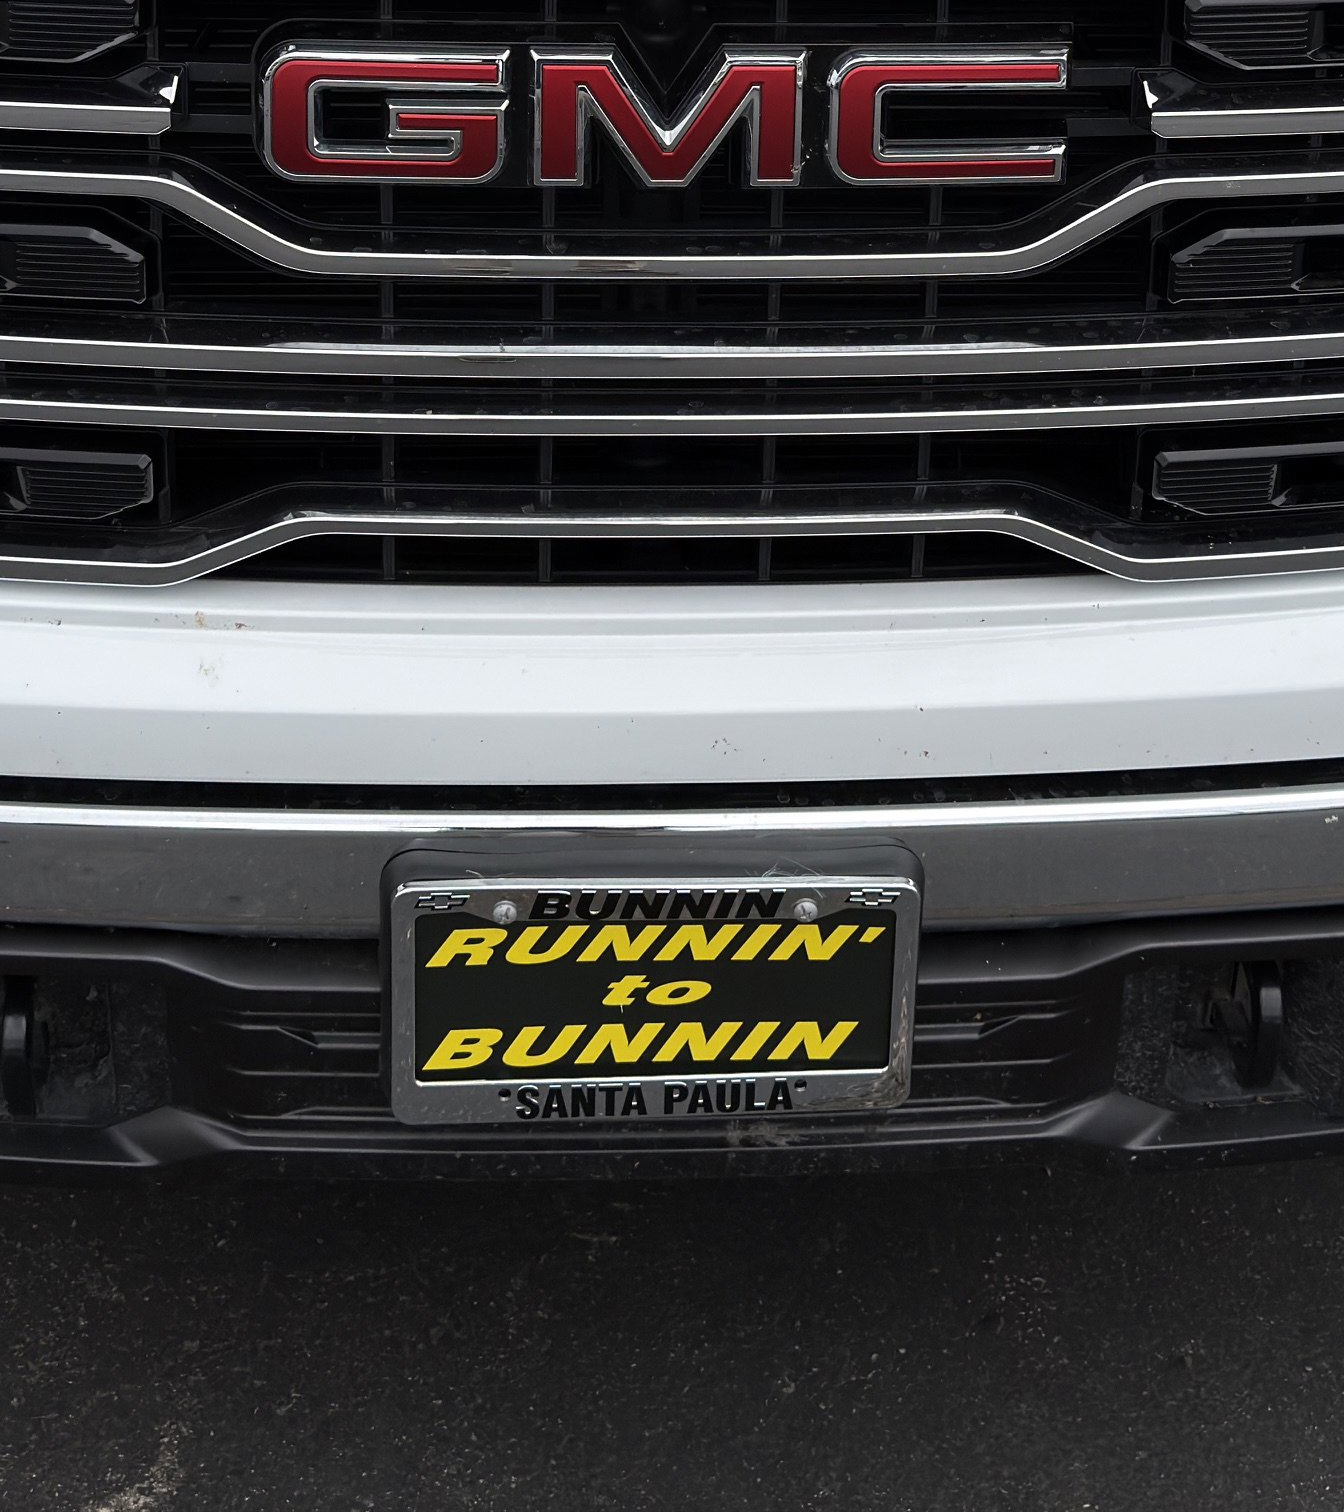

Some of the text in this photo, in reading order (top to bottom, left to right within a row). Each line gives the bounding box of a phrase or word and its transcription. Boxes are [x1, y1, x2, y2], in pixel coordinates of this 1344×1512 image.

[262, 44, 1070, 187] GMC
[528, 888, 787, 920] BUNNIN
[424, 923, 887, 969] RUNNIN'
[601, 974, 713, 1007] to
[421, 1020, 860, 1072] BUNNIN
[515, 1077, 795, 1121] SANTA PAULA
